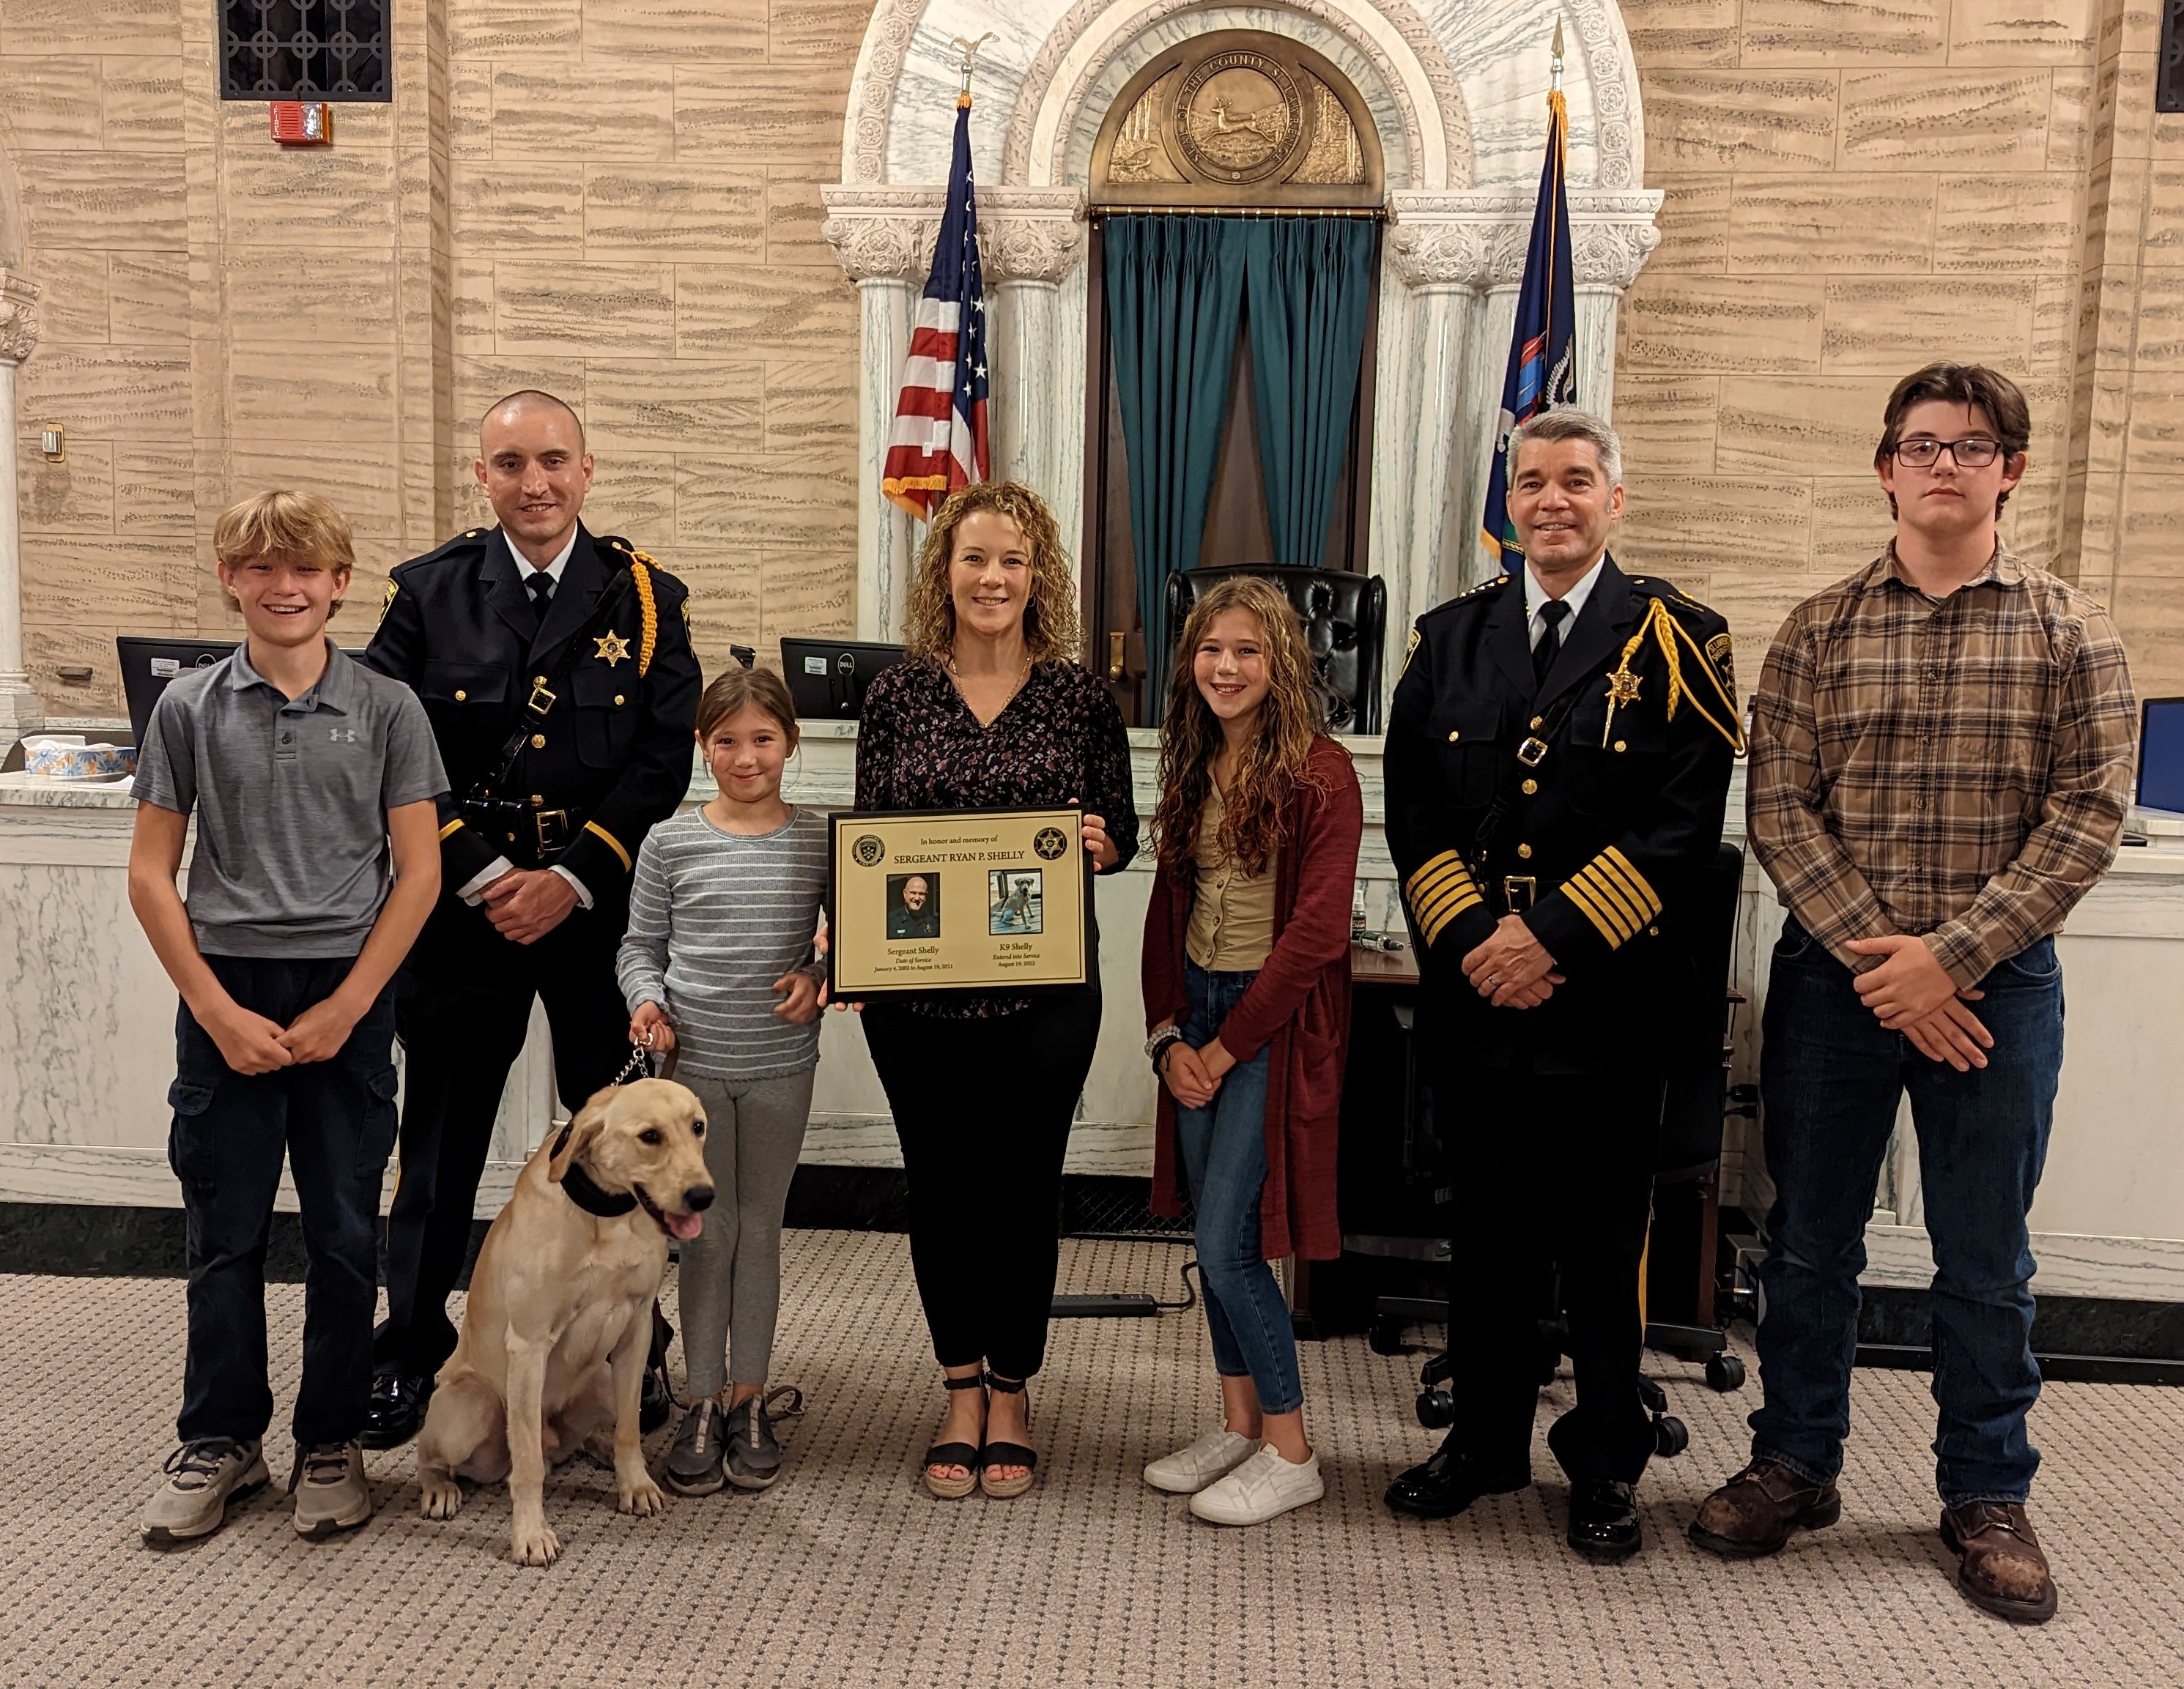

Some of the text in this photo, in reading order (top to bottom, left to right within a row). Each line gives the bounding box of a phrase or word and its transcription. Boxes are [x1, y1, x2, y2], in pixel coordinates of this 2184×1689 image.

[1185, 72, 1204, 94] THE
[1177, 105, 1188, 120] OF
[1180, 129, 1202, 163] SEAL
[894, 850, 1025, 864] SERGEANT RYAN P. SHELLY
[887, 946, 939, 957] Sergeant Shelly
[1011, 942, 1033, 952] Shelly
